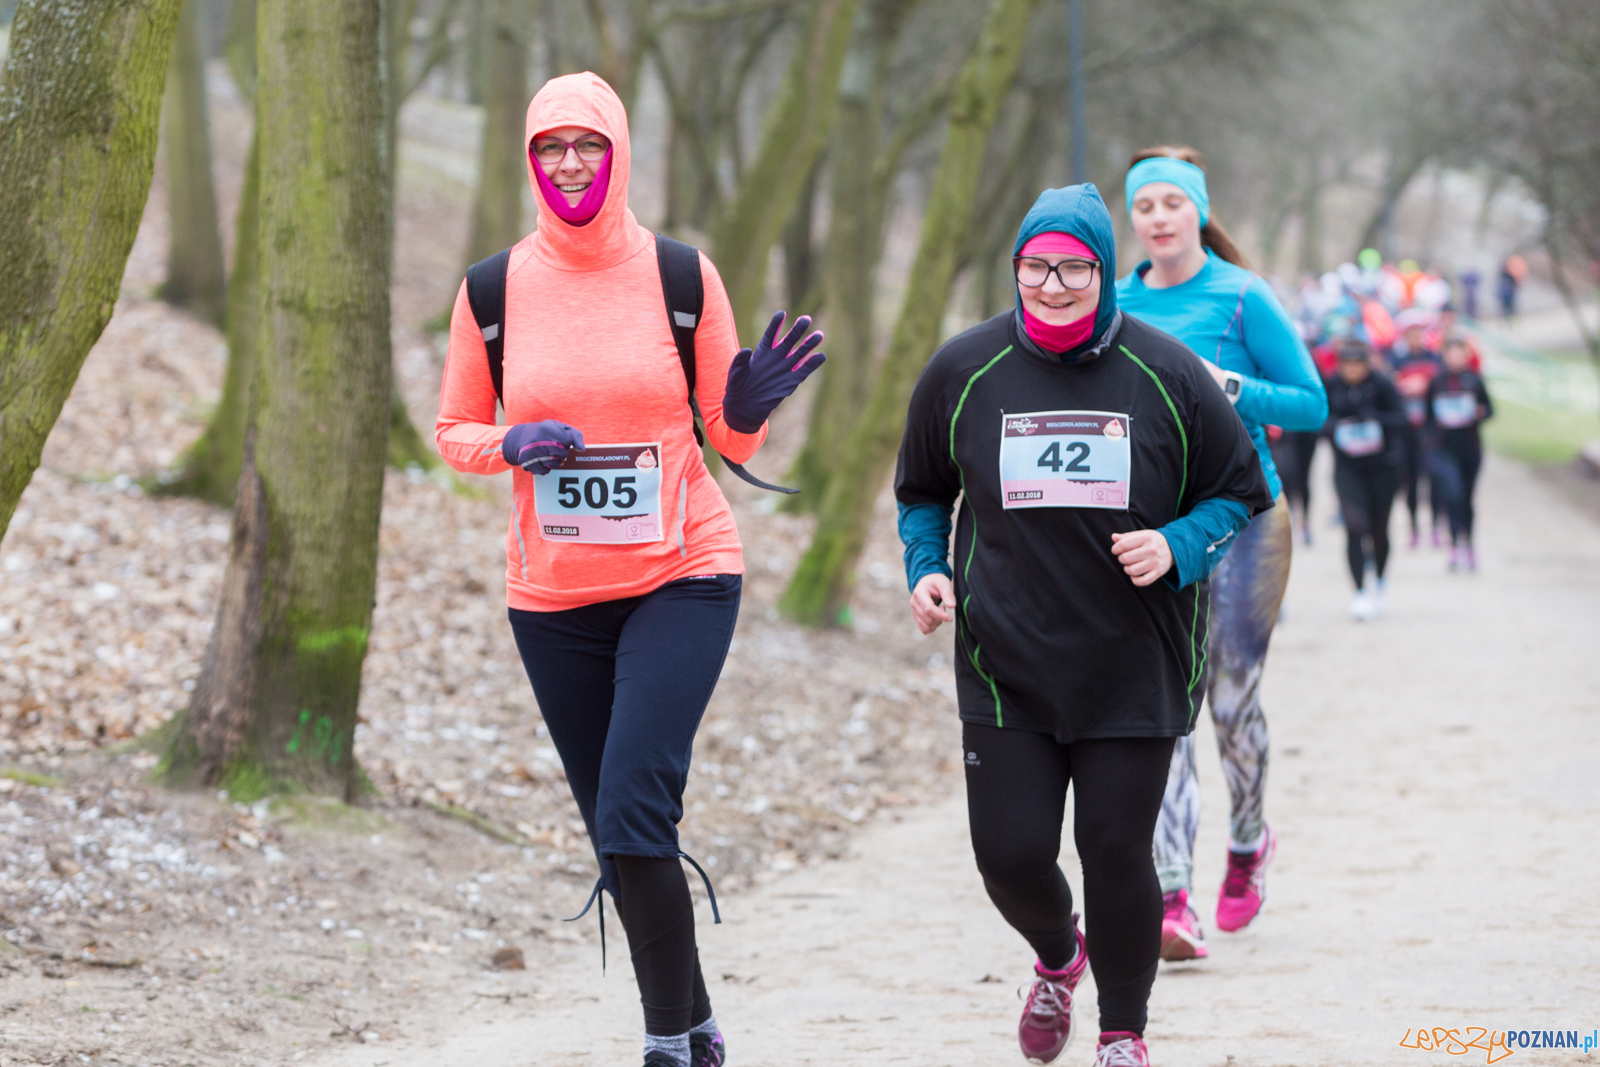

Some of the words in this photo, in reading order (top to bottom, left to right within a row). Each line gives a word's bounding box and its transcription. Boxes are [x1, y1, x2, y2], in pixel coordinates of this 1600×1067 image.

[1037, 441, 1090, 473] 42
[558, 476, 637, 509] 505
[1008, 492, 1042, 500] 11.02.2018
[545, 526, 578, 535] 11.02.2018
